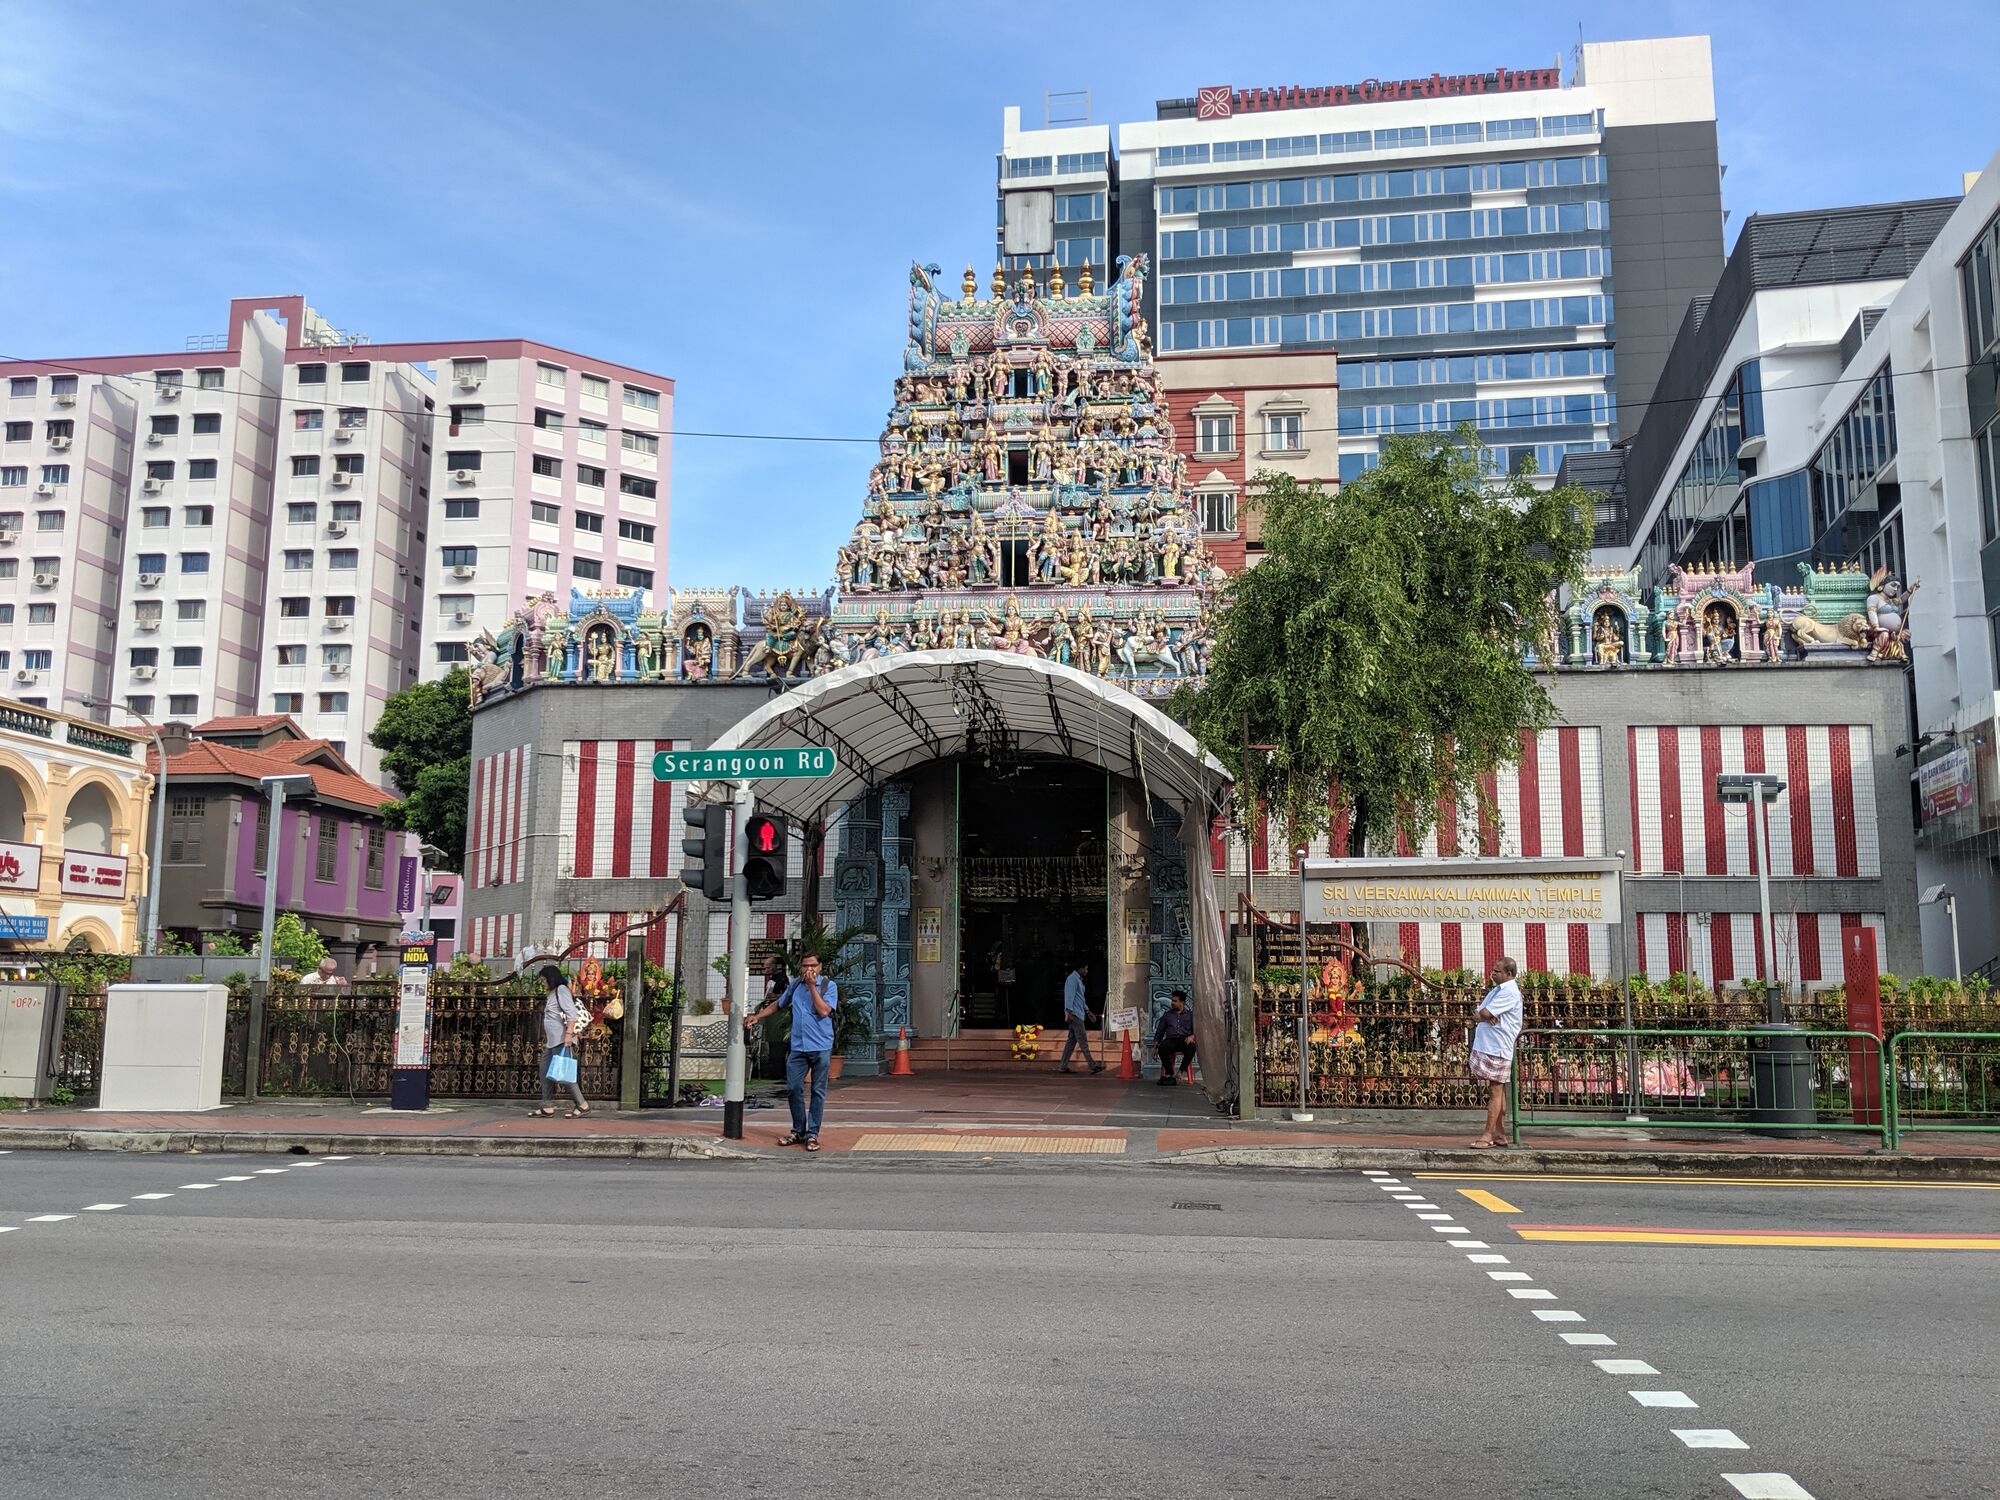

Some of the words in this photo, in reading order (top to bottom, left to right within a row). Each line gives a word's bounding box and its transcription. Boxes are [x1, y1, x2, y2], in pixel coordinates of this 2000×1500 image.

[1238, 84, 1350, 113] Hilton
[1359, 72, 1485, 103] Garden
[1496, 67, 1560, 91] Inn
[664, 754, 784, 775] Serangoon
[798, 751, 824, 769] Rd
[1323, 886, 1349, 900] SRI
[1353, 886, 1531, 901] VEERAMAKALIAMMAN
[1535, 887, 1602, 901] TEMPLE
[1323, 905, 1343, 918] 141
[1347, 905, 1431, 919] SERANGOON
[1478, 906, 1555, 919] SINGAPORE
[1558, 907, 1602, 919] 218042
[403, 952, 429, 962] INDIA
